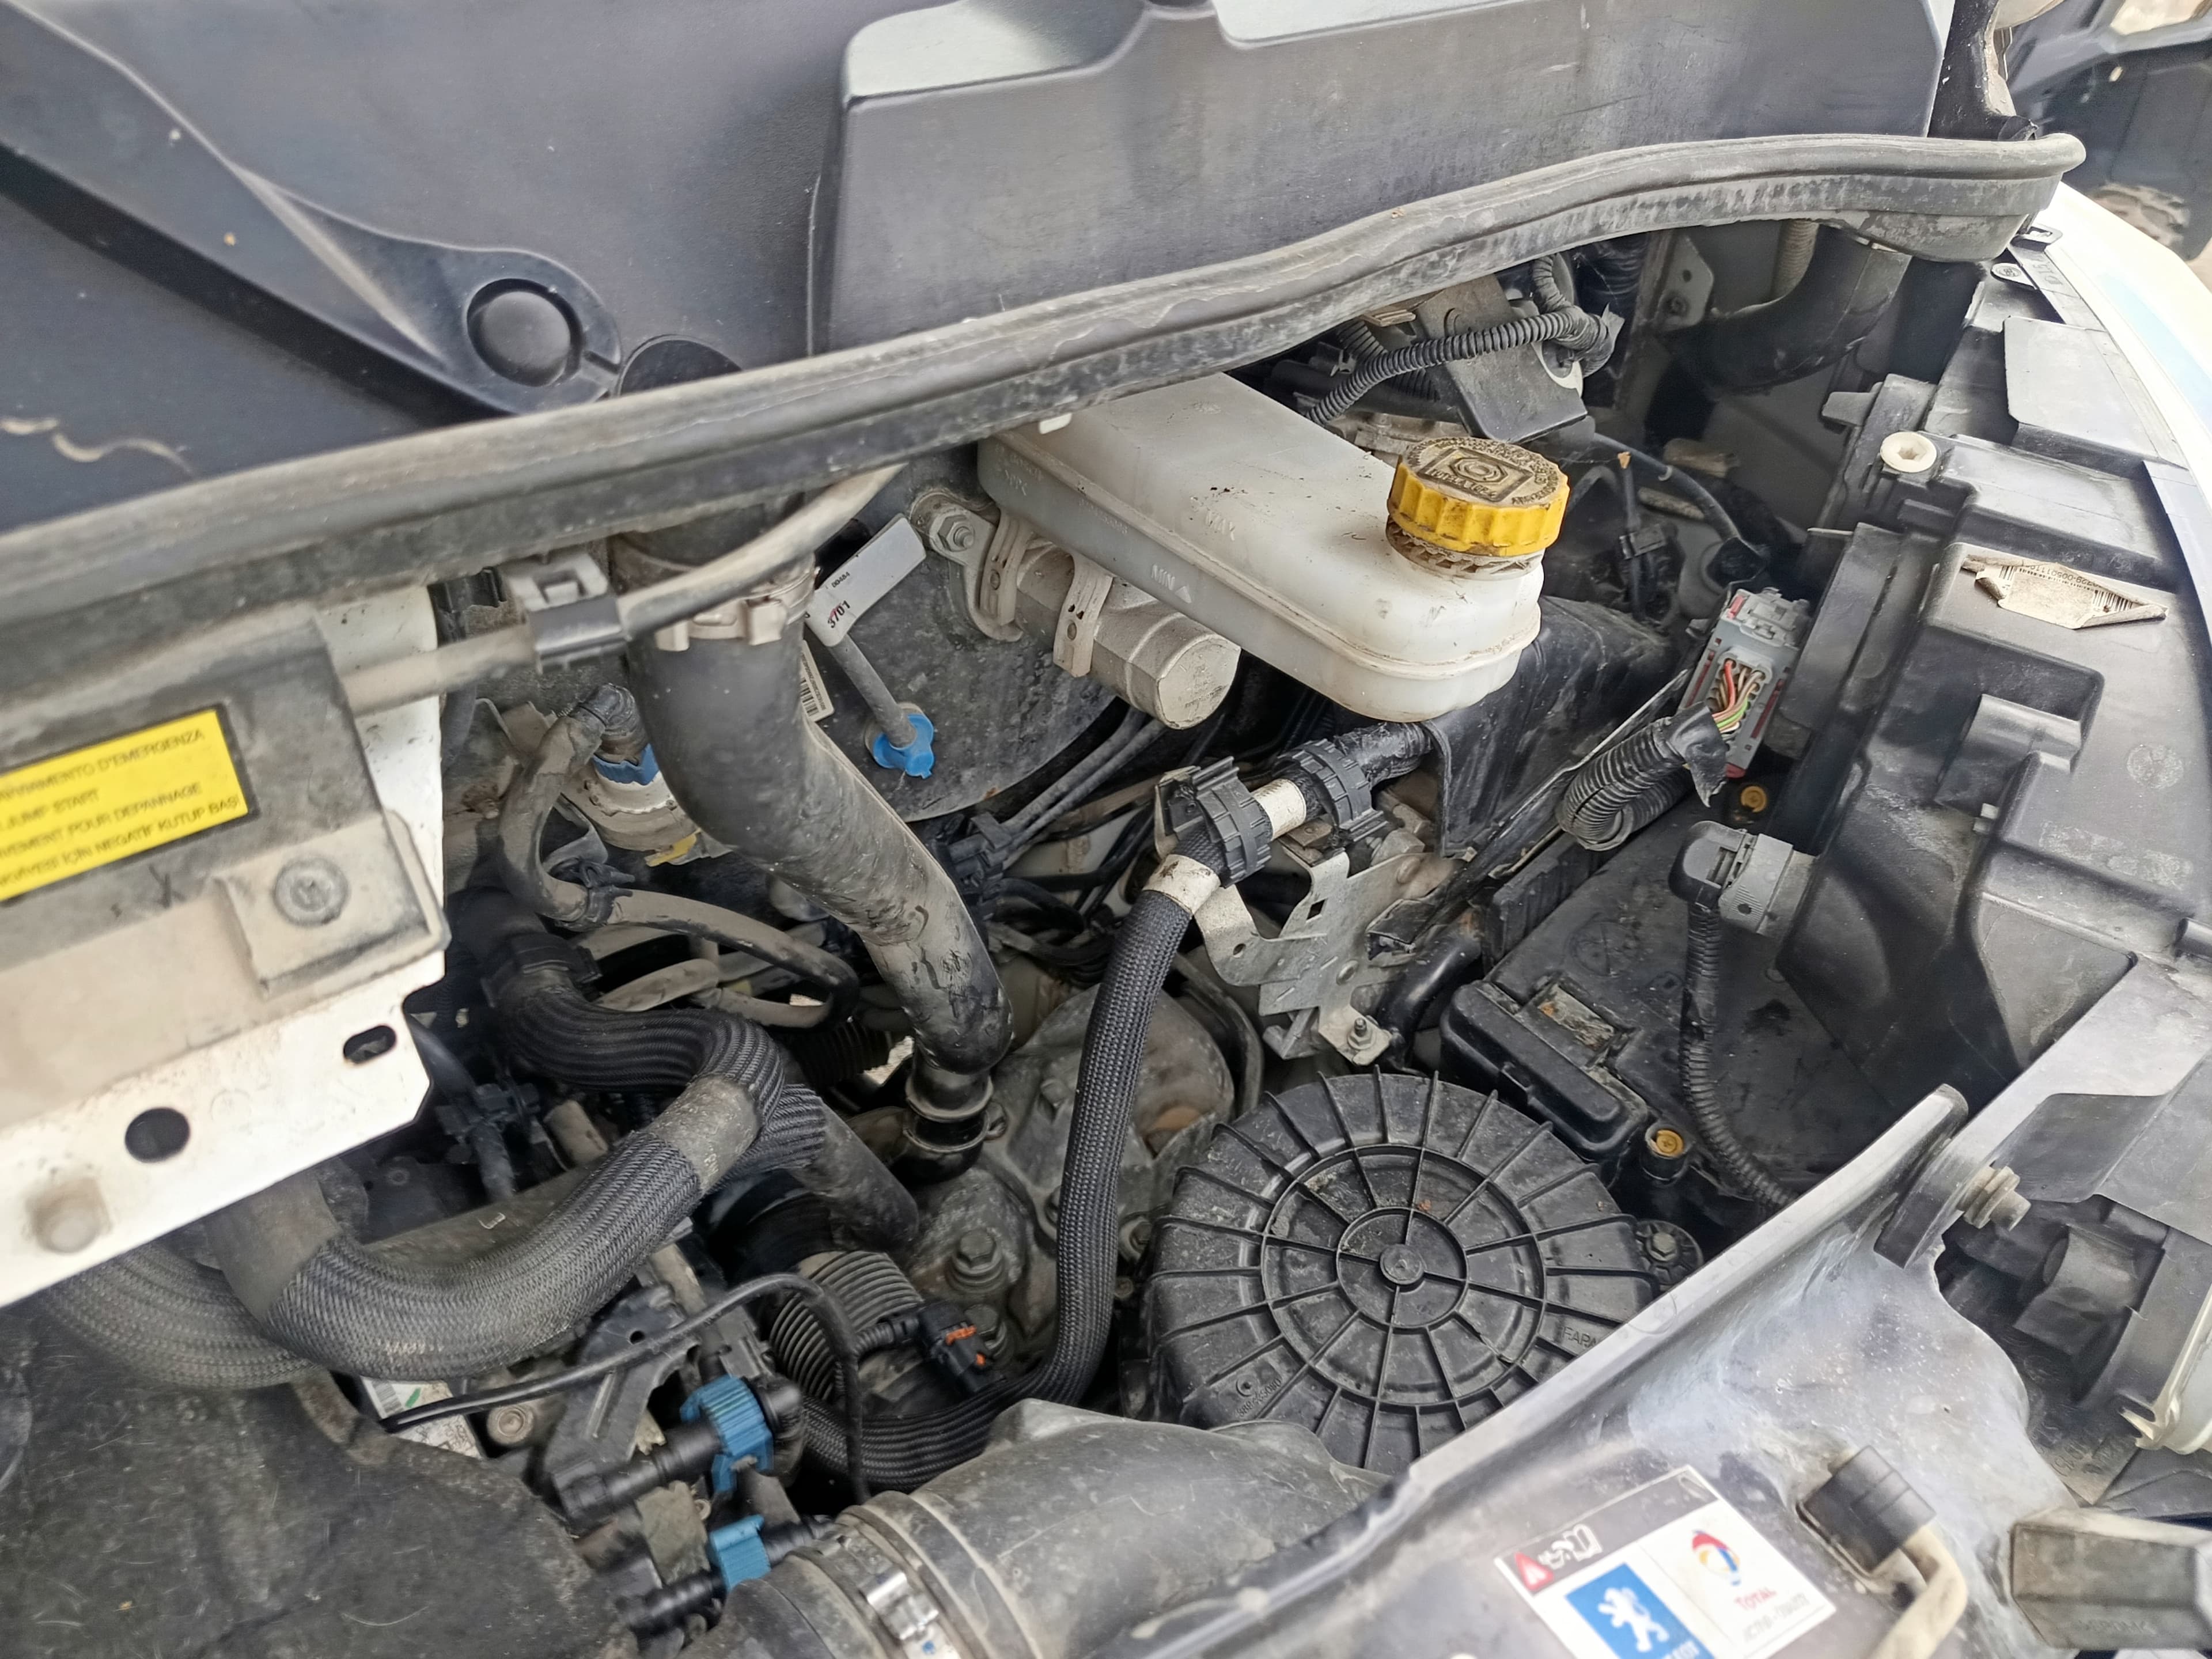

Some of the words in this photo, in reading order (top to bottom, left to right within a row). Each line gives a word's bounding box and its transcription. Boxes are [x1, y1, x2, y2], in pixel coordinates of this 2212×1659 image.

[1152, 564, 1176, 590] MIN
[828, 600, 851, 628] 3701
[97, 729, 205, 772] D'EMERGENZA
[53, 787, 99, 814] START
[68, 813, 111, 835] POUR
[113, 782, 202, 821] DEPANNAGE
[157, 807, 205, 832] KUTUP
[1734, 1587, 1777, 1609] TOTAL
